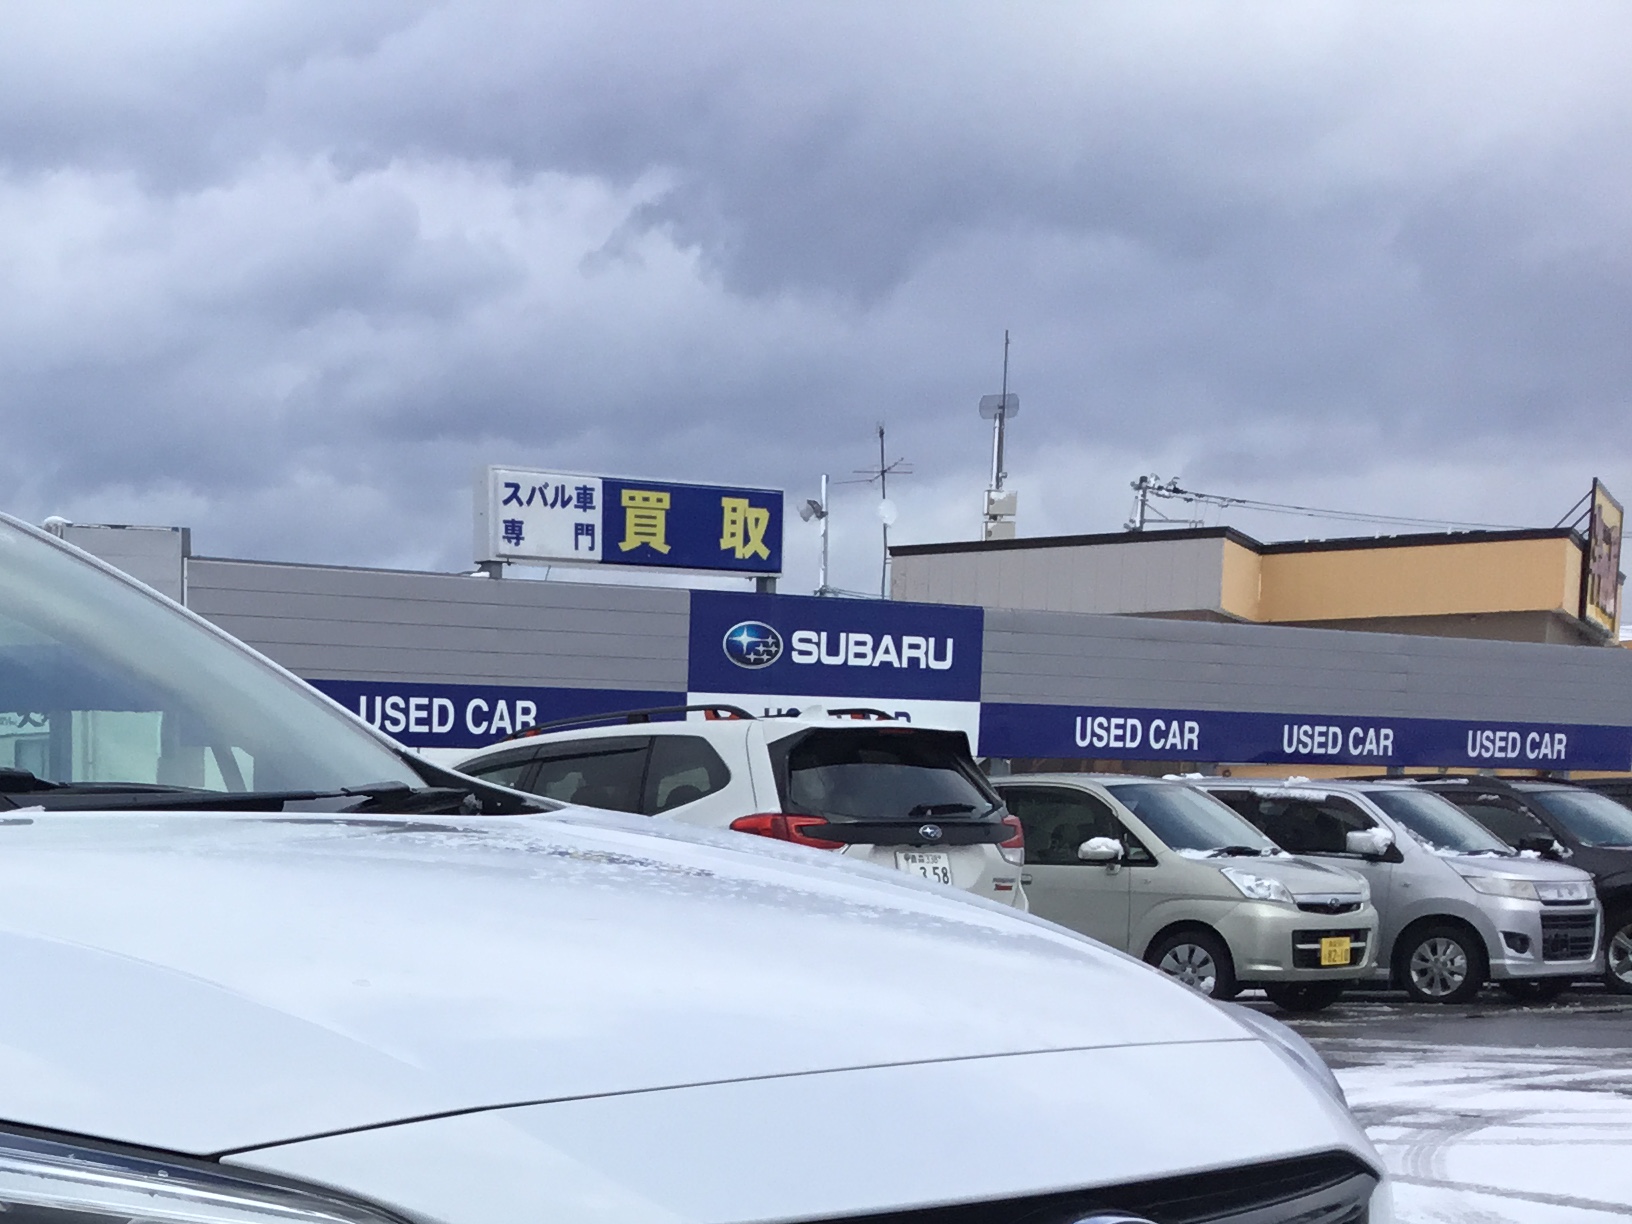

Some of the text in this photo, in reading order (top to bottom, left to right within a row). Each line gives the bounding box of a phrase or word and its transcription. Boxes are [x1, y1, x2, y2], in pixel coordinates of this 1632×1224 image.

[502, 481, 596, 512] スバル車
[503, 518, 595, 551] 専門
[618, 488, 771, 560] 買取
[791, 630, 954, 670] SUBARU
[359, 695, 537, 734] USED CAR
[1075, 717, 1200, 750] USED CAR
[1283, 724, 1394, 756] USED CAR
[1467, 730, 1567, 759] USED CAR
